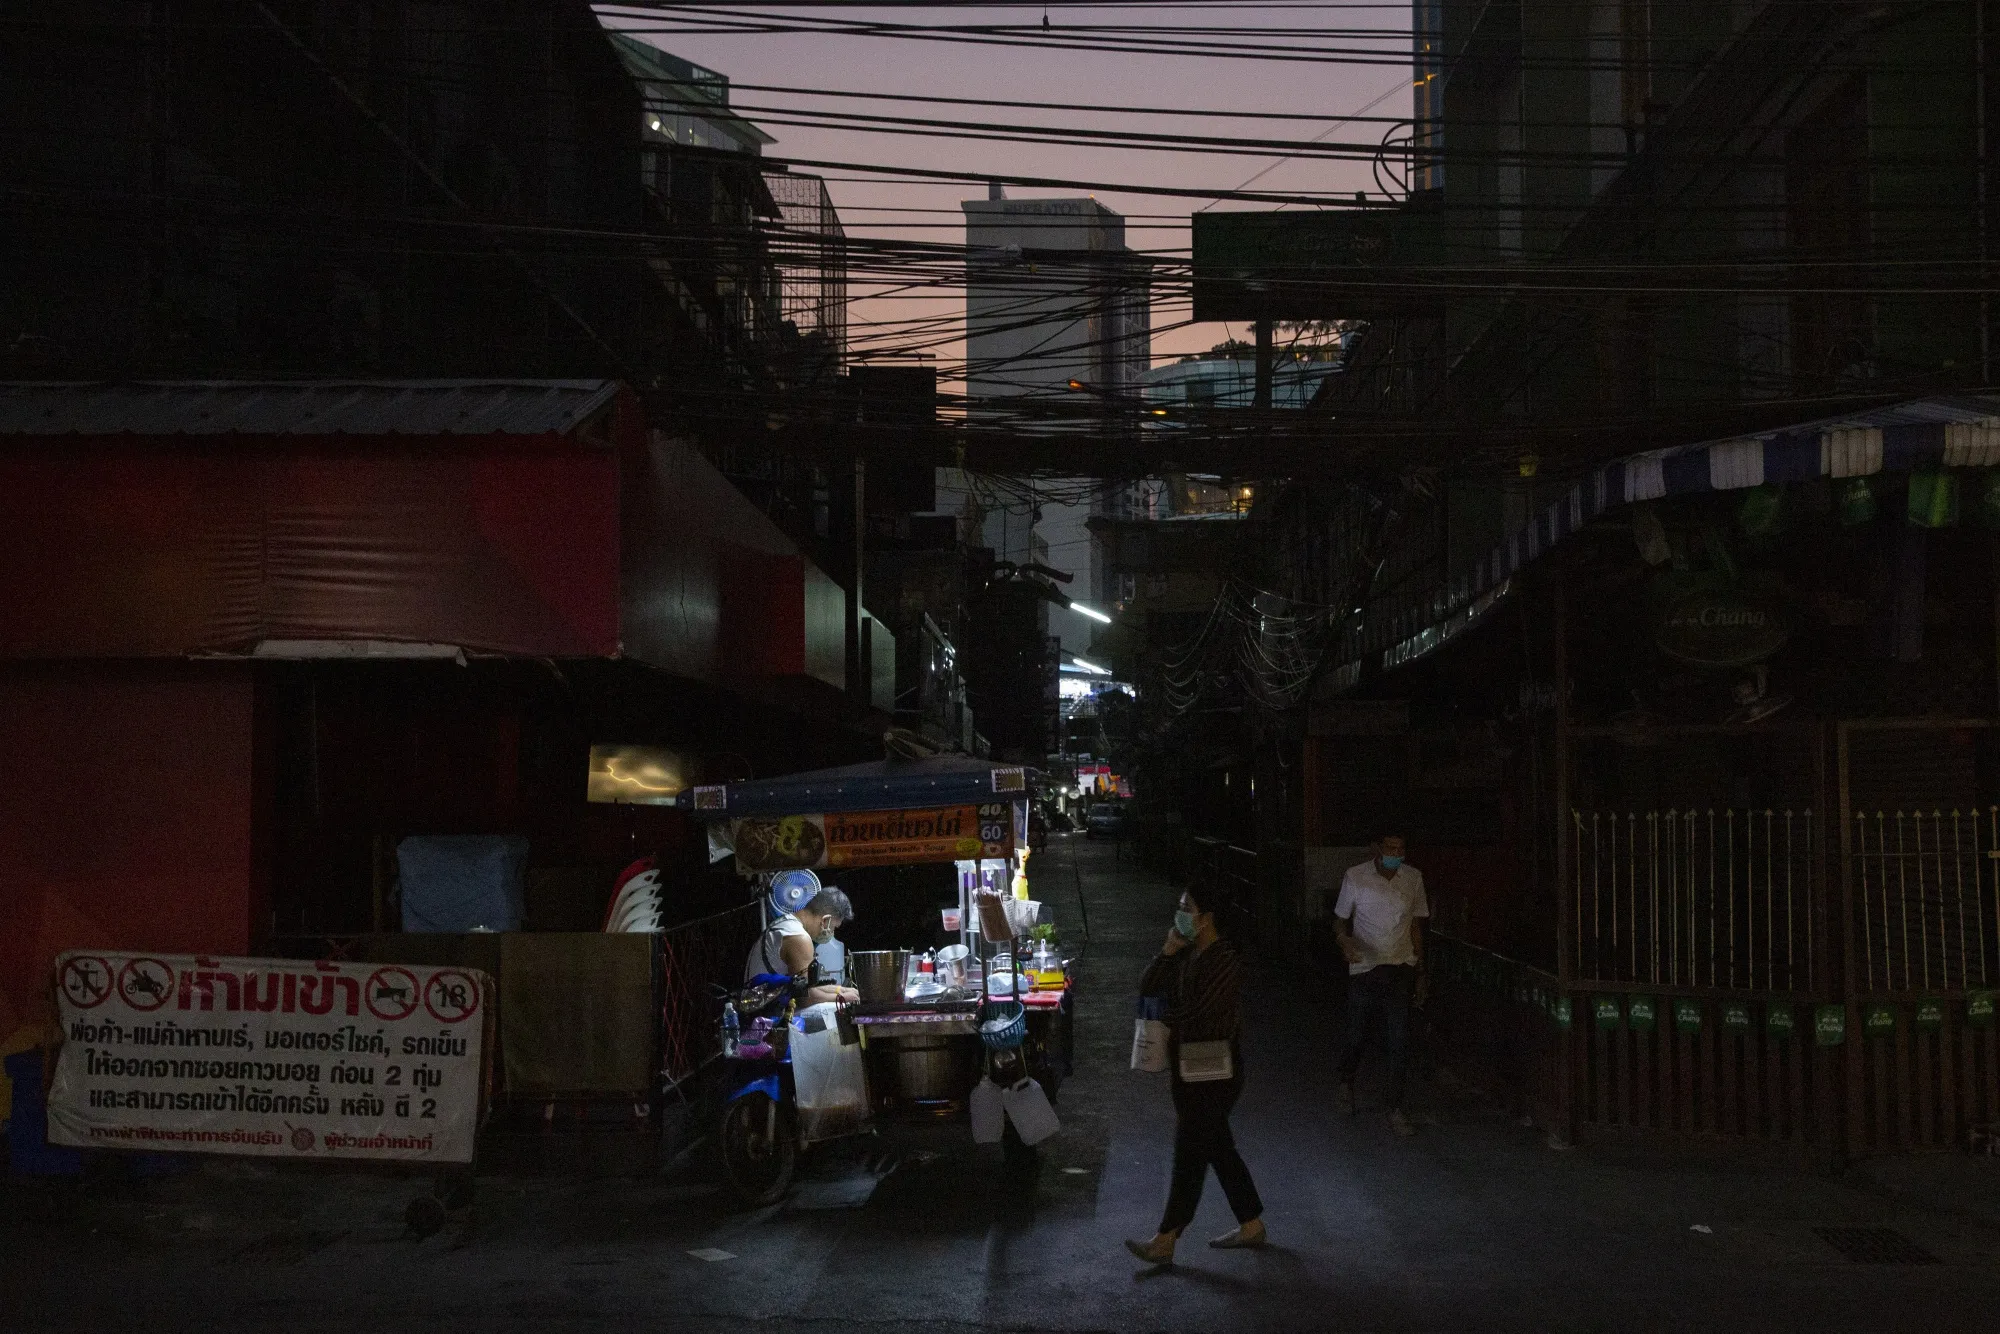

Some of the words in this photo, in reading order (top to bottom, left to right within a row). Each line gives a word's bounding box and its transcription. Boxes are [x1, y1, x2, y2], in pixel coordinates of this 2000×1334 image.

[981, 825, 1002, 840] 60
[177, 956, 360, 1017] ห้ามเข้า
[401, 1029, 467, 1057] รถเข็น
[330, 1060, 374, 1085] ก่อน
[385, 1065, 402, 1086] 2
[413, 1063, 442, 1093] ทุ่ม
[89, 1084, 329, 1115] และสามารถเข้าได้อีกครั้ง
[341, 1091, 385, 1117] หลัง
[395, 1094, 411, 1118] ตี
[420, 1097, 437, 1119] 2
